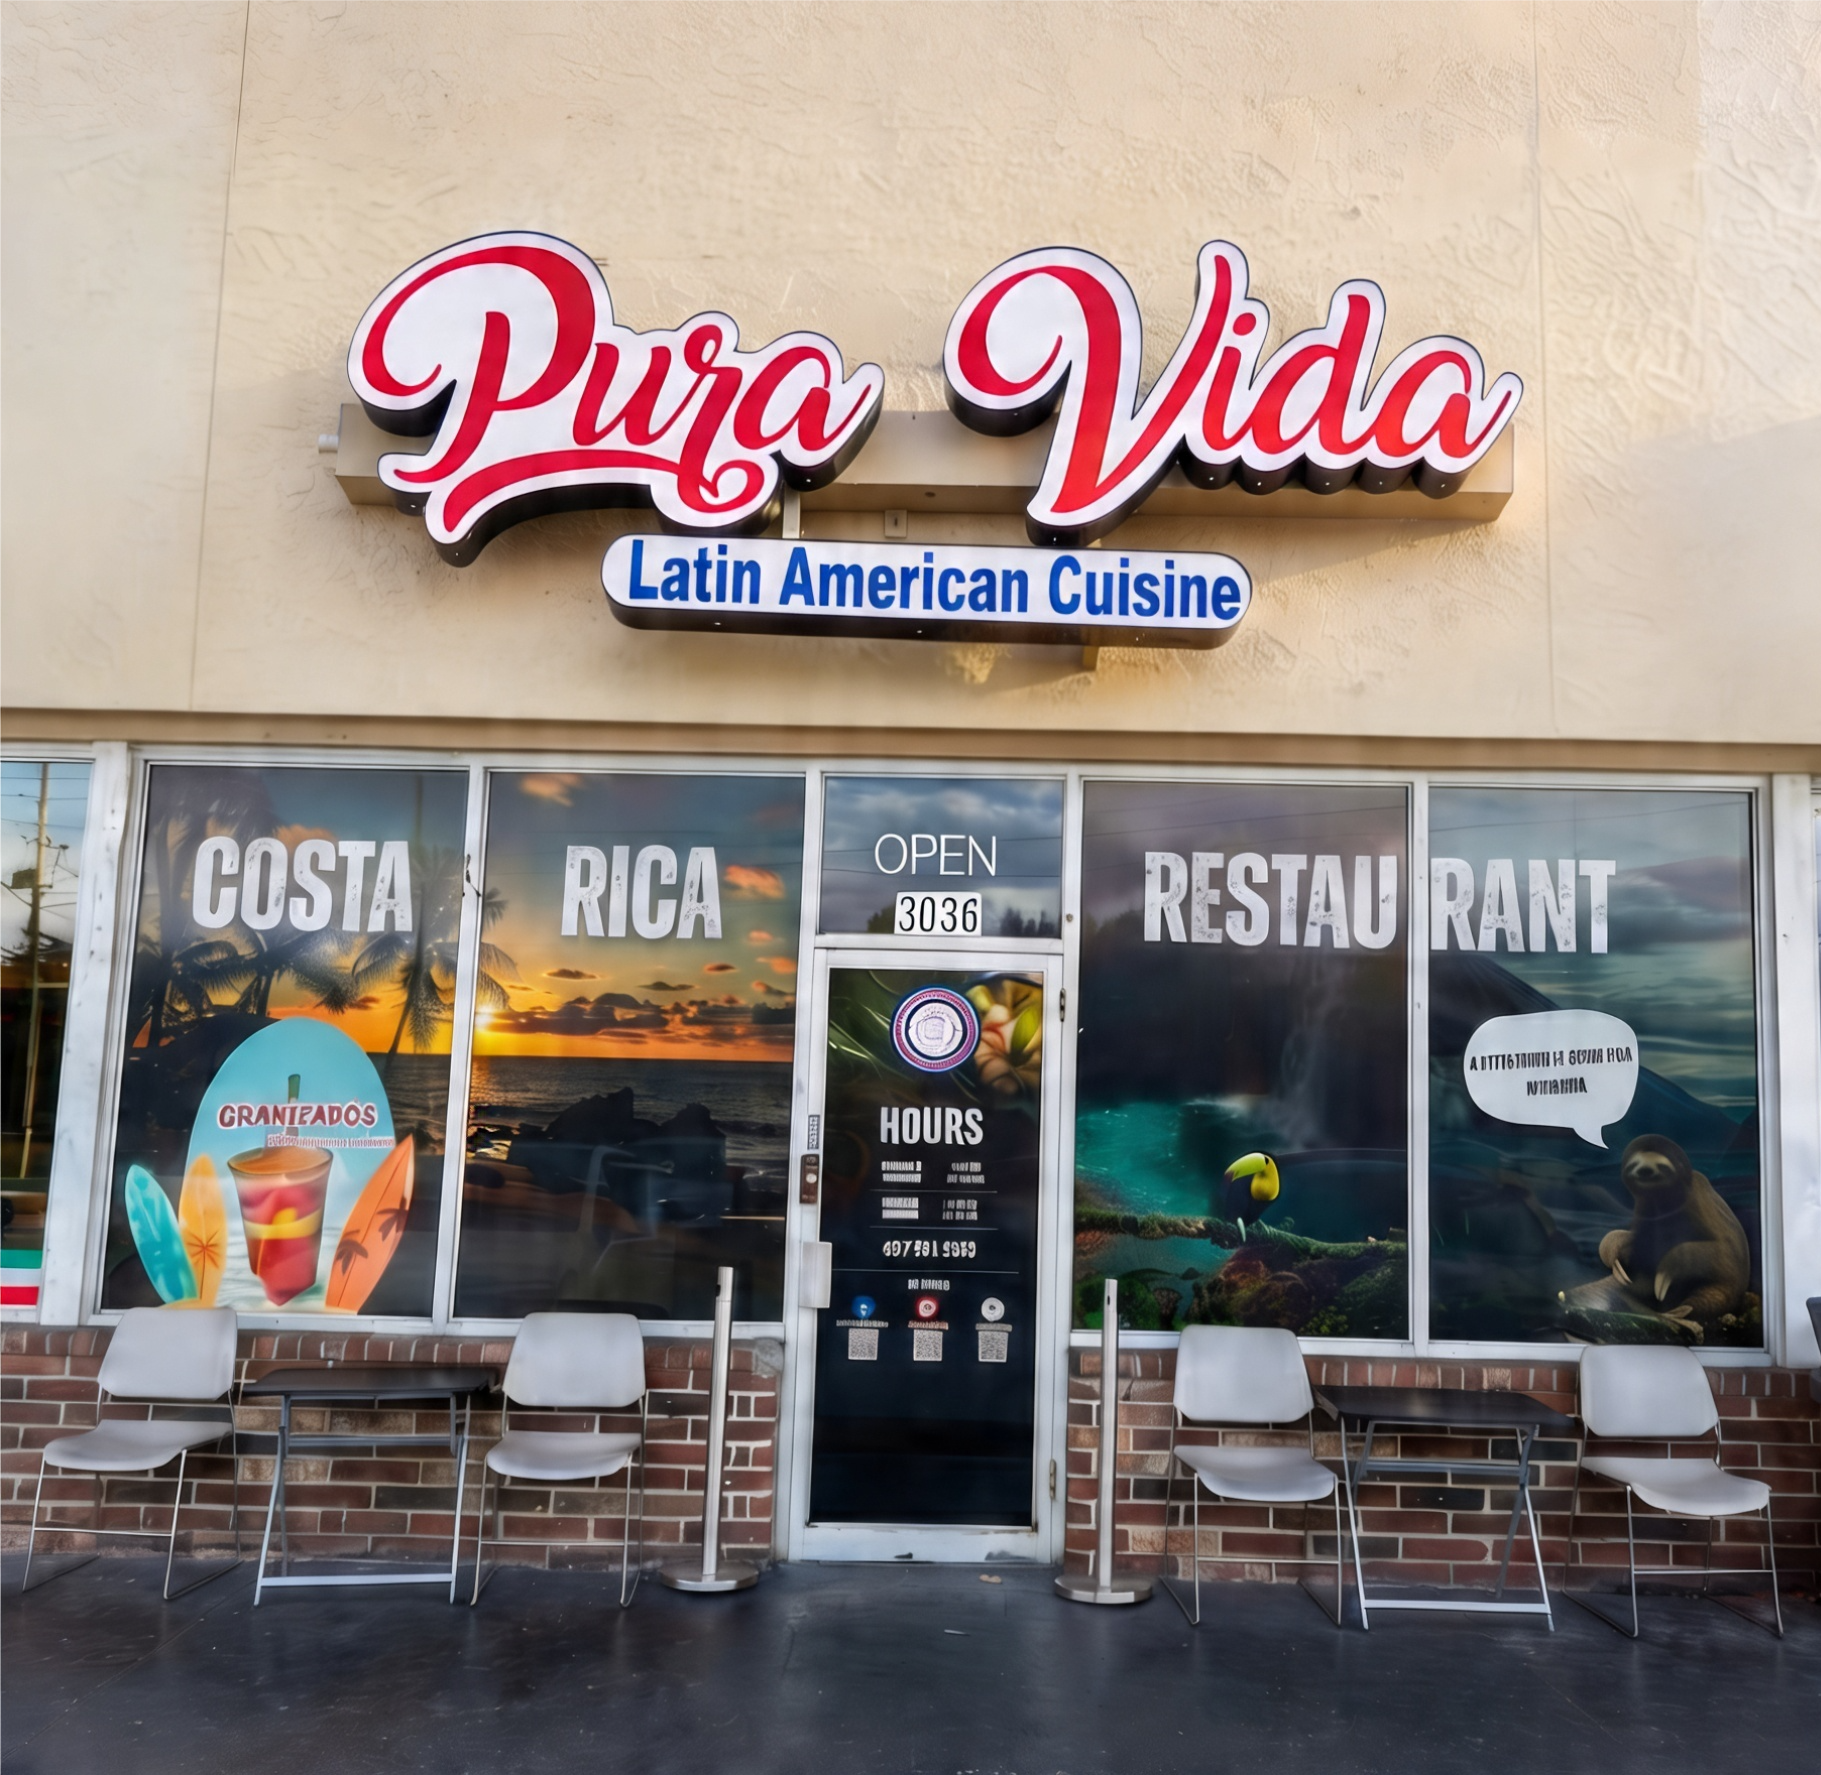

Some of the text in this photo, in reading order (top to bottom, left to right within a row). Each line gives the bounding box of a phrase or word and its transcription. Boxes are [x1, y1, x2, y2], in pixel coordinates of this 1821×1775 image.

[362, 246, 1512, 532] Pura Vida
[628, 538, 1241, 621] Latin American Cuisine
[874, 832, 997, 877] OPEN
[191, 835, 723, 940] COSTA RICA
[898, 895, 979, 933] 3036
[879, 1106, 984, 1146] HOURS
